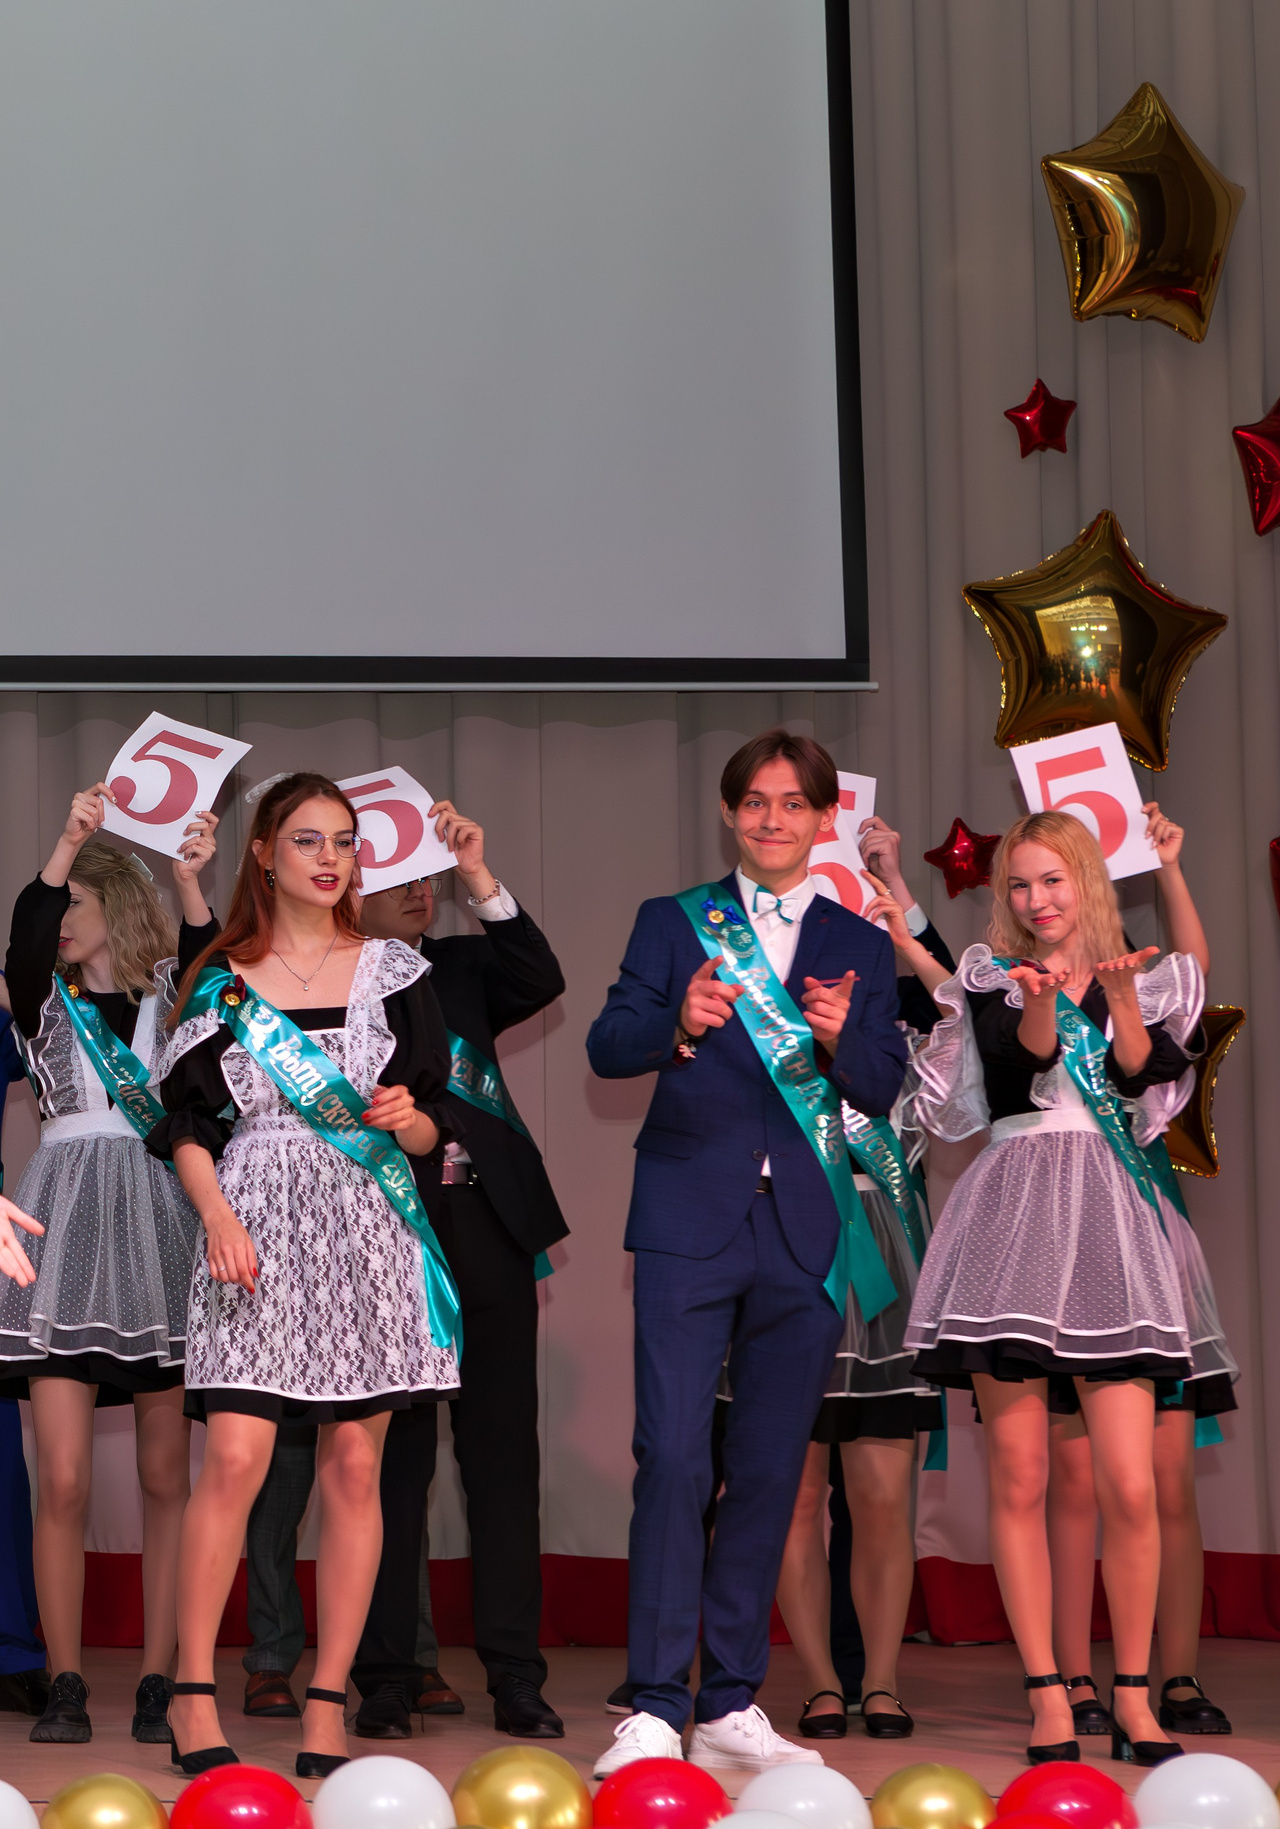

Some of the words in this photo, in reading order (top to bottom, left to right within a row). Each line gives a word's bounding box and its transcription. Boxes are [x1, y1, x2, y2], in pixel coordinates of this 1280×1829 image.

[110, 730, 224, 825] 5
[341, 779, 424, 869] 5
[1036, 746, 1128, 860] 5
[268, 1034, 387, 1163] Выпускница
[381, 1155, 421, 1213] 2024
